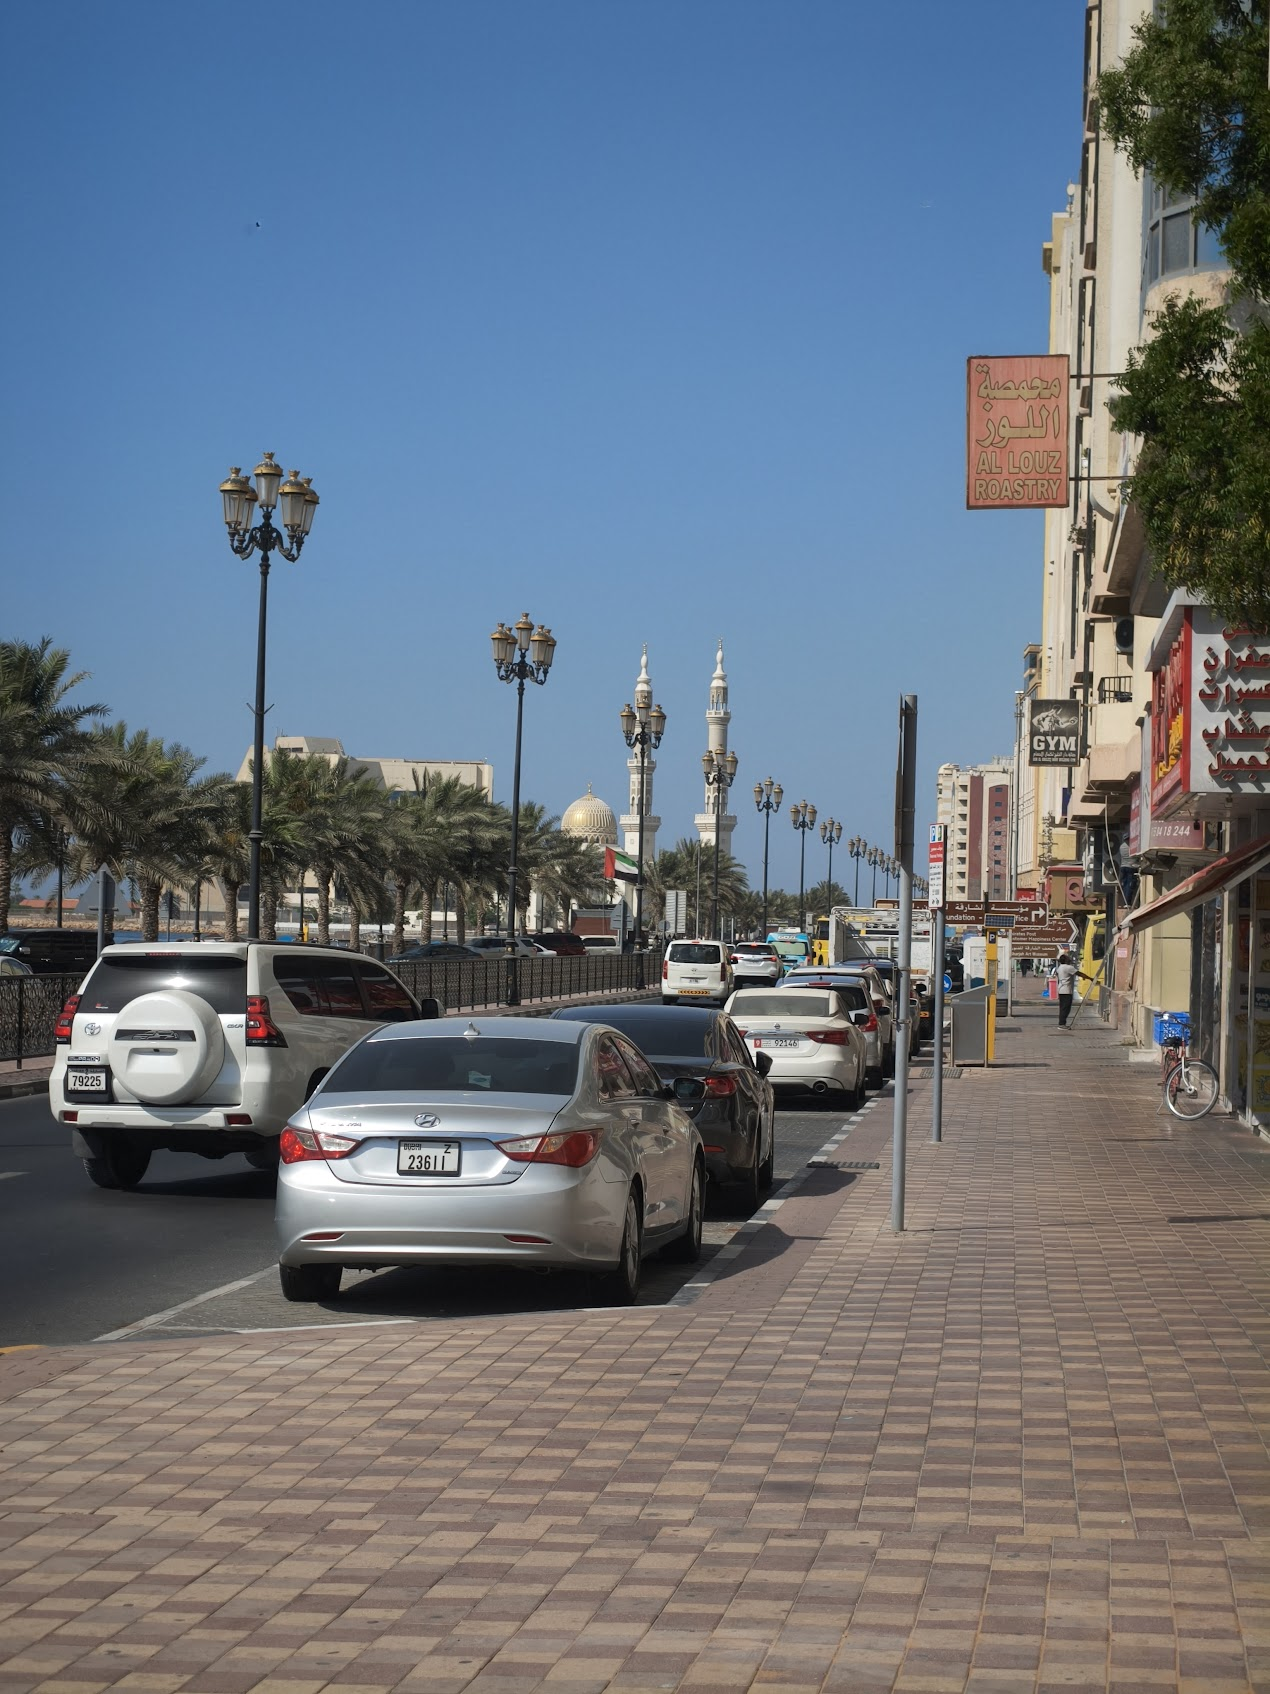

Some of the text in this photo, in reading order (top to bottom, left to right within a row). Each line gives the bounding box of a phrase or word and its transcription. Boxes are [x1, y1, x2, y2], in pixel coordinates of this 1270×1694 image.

[975, 364, 1061, 402] محمصة
[975, 402, 1060, 448] اللوز
[976, 451, 1061, 474] AL LOUZ
[975, 479, 1061, 500] ROASTRY
[1203, 644, 1270, 671] عفران
[1202, 710, 1270, 749] عشاب
[1033, 735, 1076, 751] GYM
[955, 903, 1029, 912] مؤسسة لشارقة
[989, 933, 995, 941] P
[774, 1039, 798, 1047] 92146
[72, 1075, 102, 1087] 79225
[444, 1144, 452, 1154] Z
[408, 1155, 445, 1170] 23611
